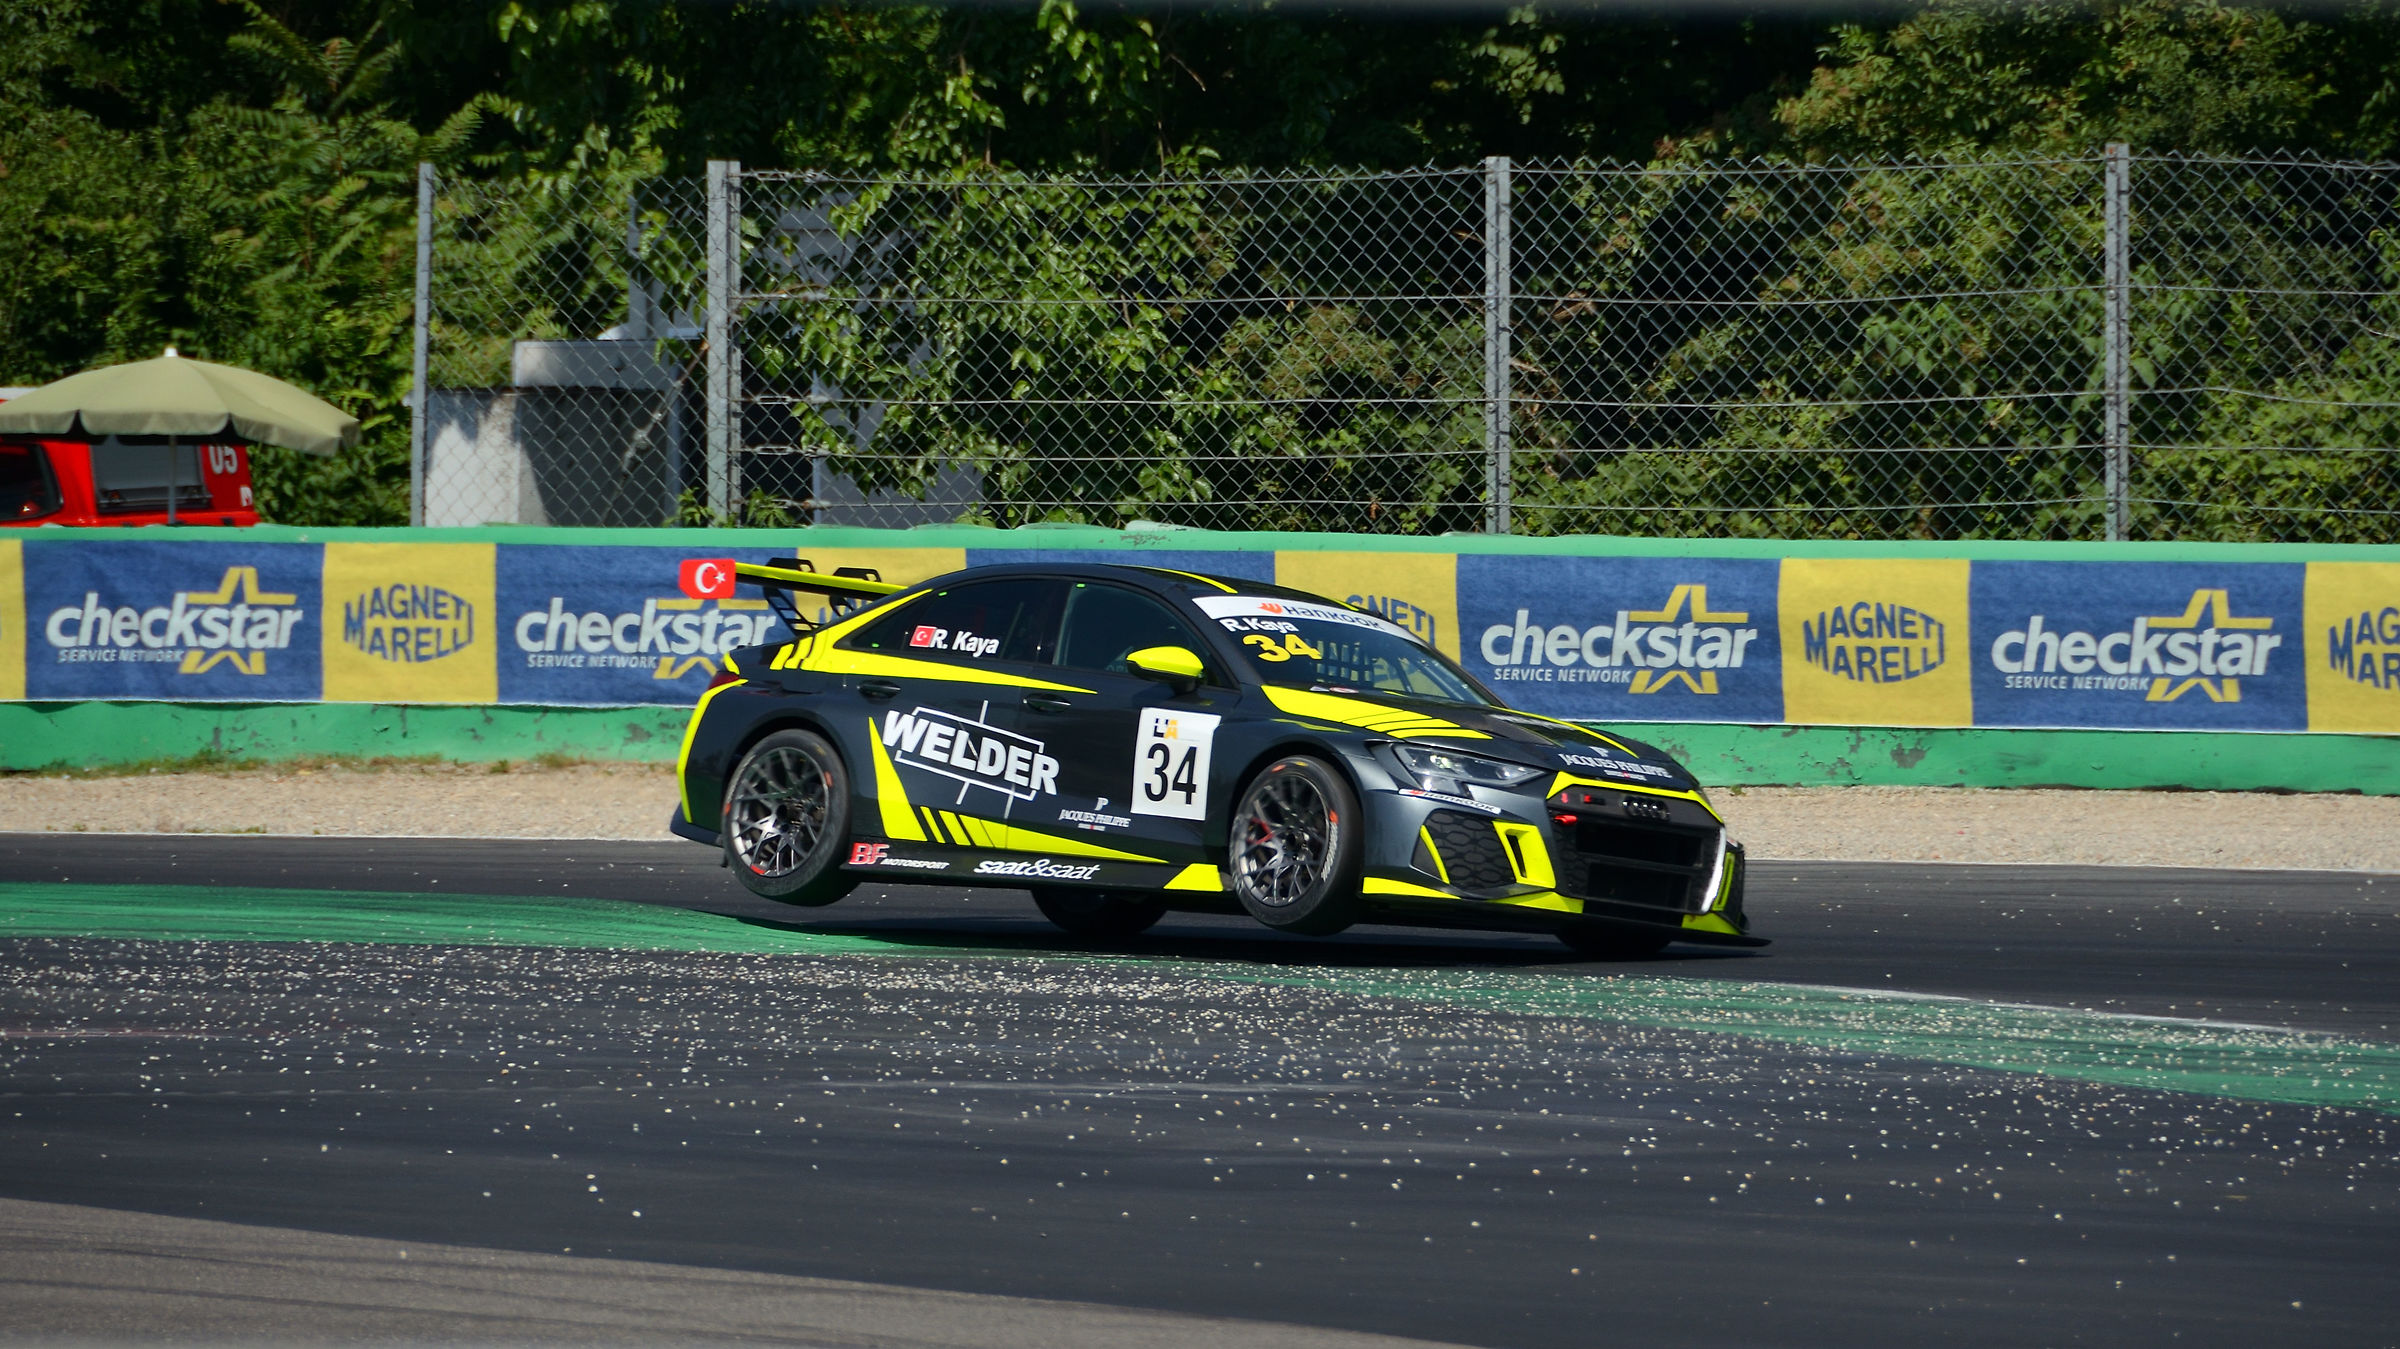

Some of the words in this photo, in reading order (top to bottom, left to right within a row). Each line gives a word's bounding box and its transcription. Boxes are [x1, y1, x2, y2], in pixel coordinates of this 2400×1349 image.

[344, 583, 474, 622] MAGNETI
[46, 592, 303, 649] checkstar
[515, 597, 776, 655] checkstar
[1803, 601, 1945, 641] MAGNETI
[344, 622, 474, 663] MARELLI
[930, 628, 948, 650] R.
[952, 631, 1000, 658] Kaya
[1242, 633, 1322, 662] 34
[1480, 609, 1758, 668] checkstar
[1991, 615, 2282, 676] checkstar
[58, 649, 118, 663] SERVICE
[120, 650, 184, 662] NETWORK
[527, 654, 585, 668] SERVICE
[590, 655, 657, 668] NETWORK
[1803, 641, 1945, 683] MARELLI
[1494, 668, 1553, 682] SERVICE
[1557, 669, 1632, 683] NETWORK
[2004, 676, 2067, 689] SERVICE
[2072, 676, 2150, 691] NETWORK
[882, 710, 1060, 796] WELDER
[1558, 753, 1616, 770] JACQUES
[1615, 760, 1673, 779] PHILIPPE
[1145, 743, 1197, 805] 34
[1058, 809, 1096, 823] JACQUES
[1095, 814, 1132, 828] PHILIPPE
[849, 842, 889, 865] BF
[880, 858, 950, 870] MOTORSPORT
[974, 858, 1100, 880] saat&saat
